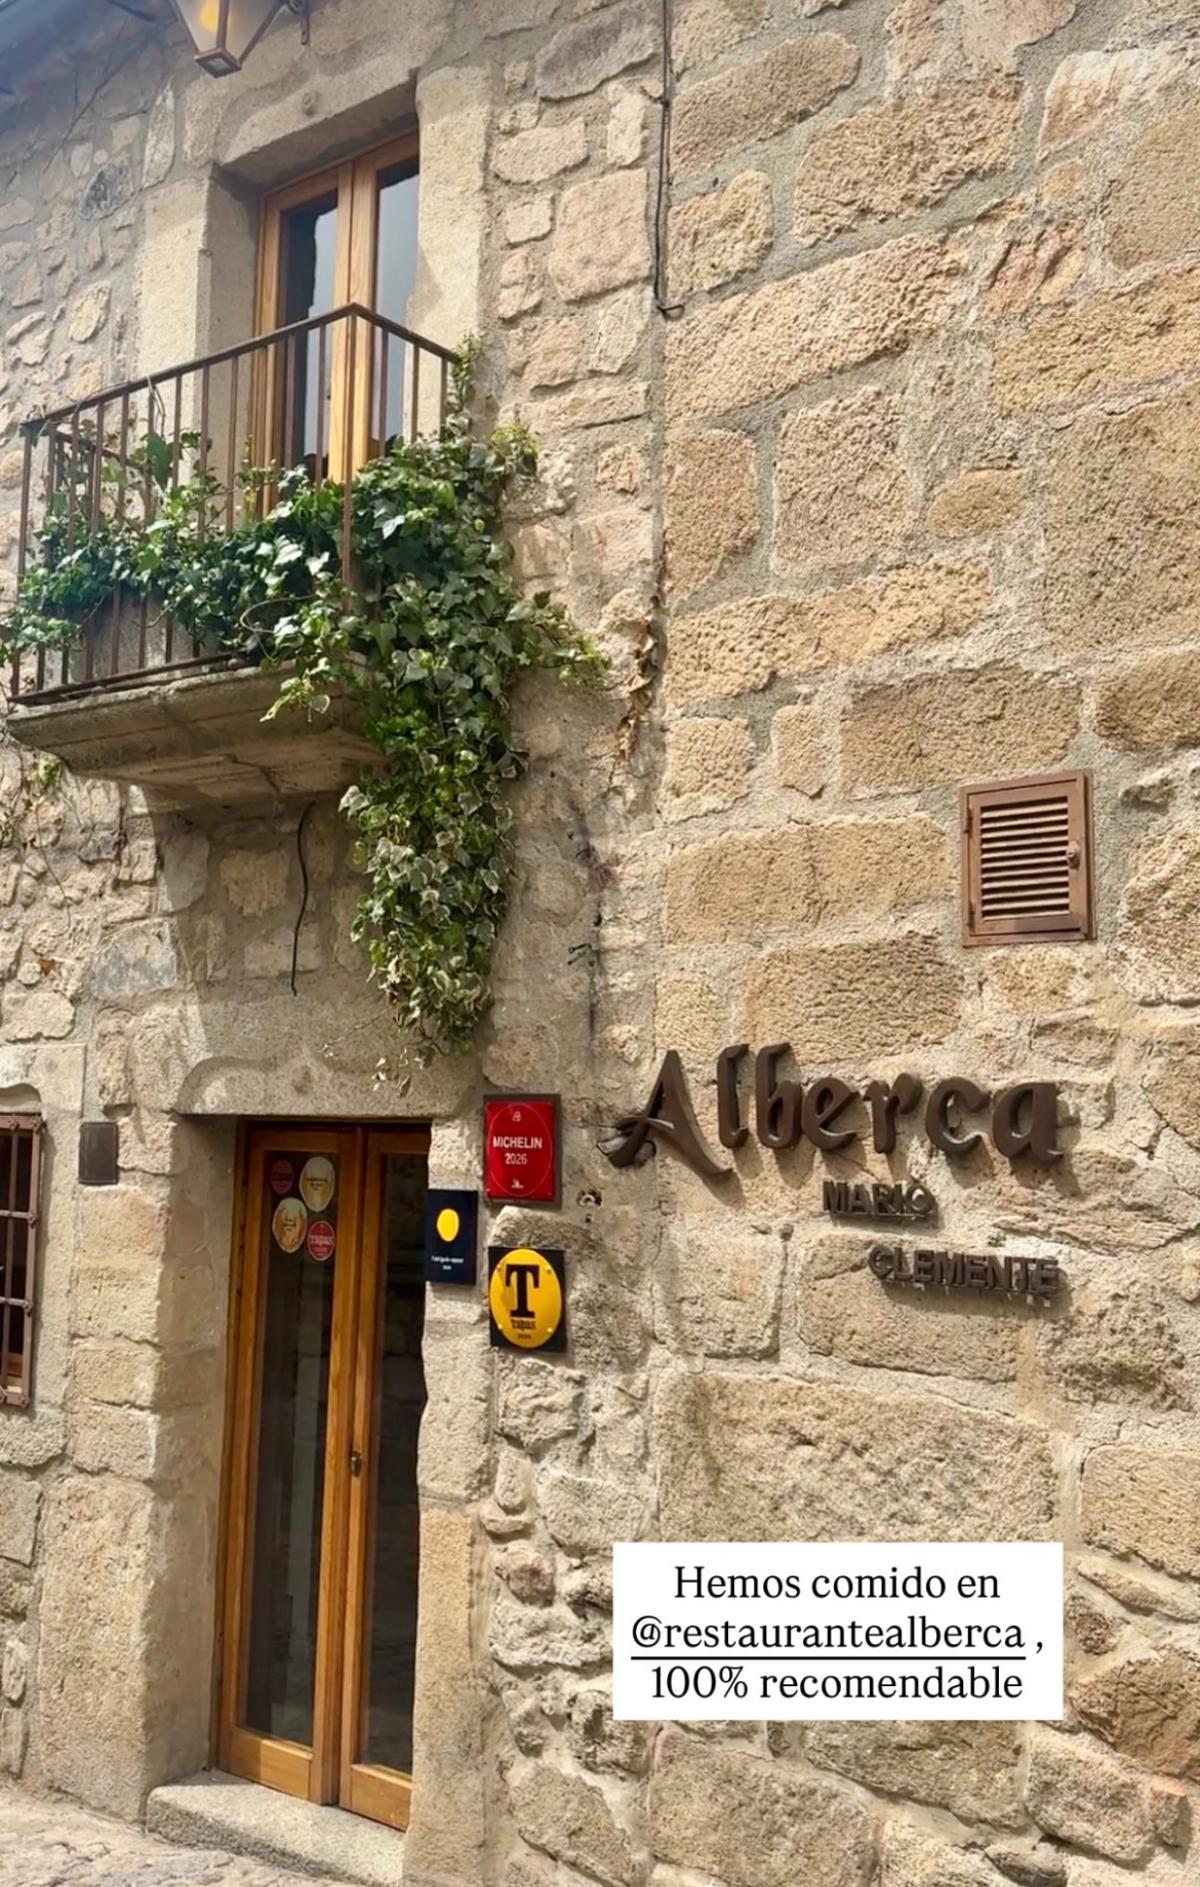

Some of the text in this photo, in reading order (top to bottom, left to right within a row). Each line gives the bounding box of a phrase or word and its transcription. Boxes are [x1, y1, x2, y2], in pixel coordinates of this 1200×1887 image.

[597, 1042, 1064, 1175] Alberca
[493, 1136, 542, 1149] MICHELIN
[504, 1152, 528, 1165] 2026
[823, 1178, 934, 1214] MARIO
[868, 1246, 1060, 1293] CLEMENTE
[505, 1264, 539, 1318] T
